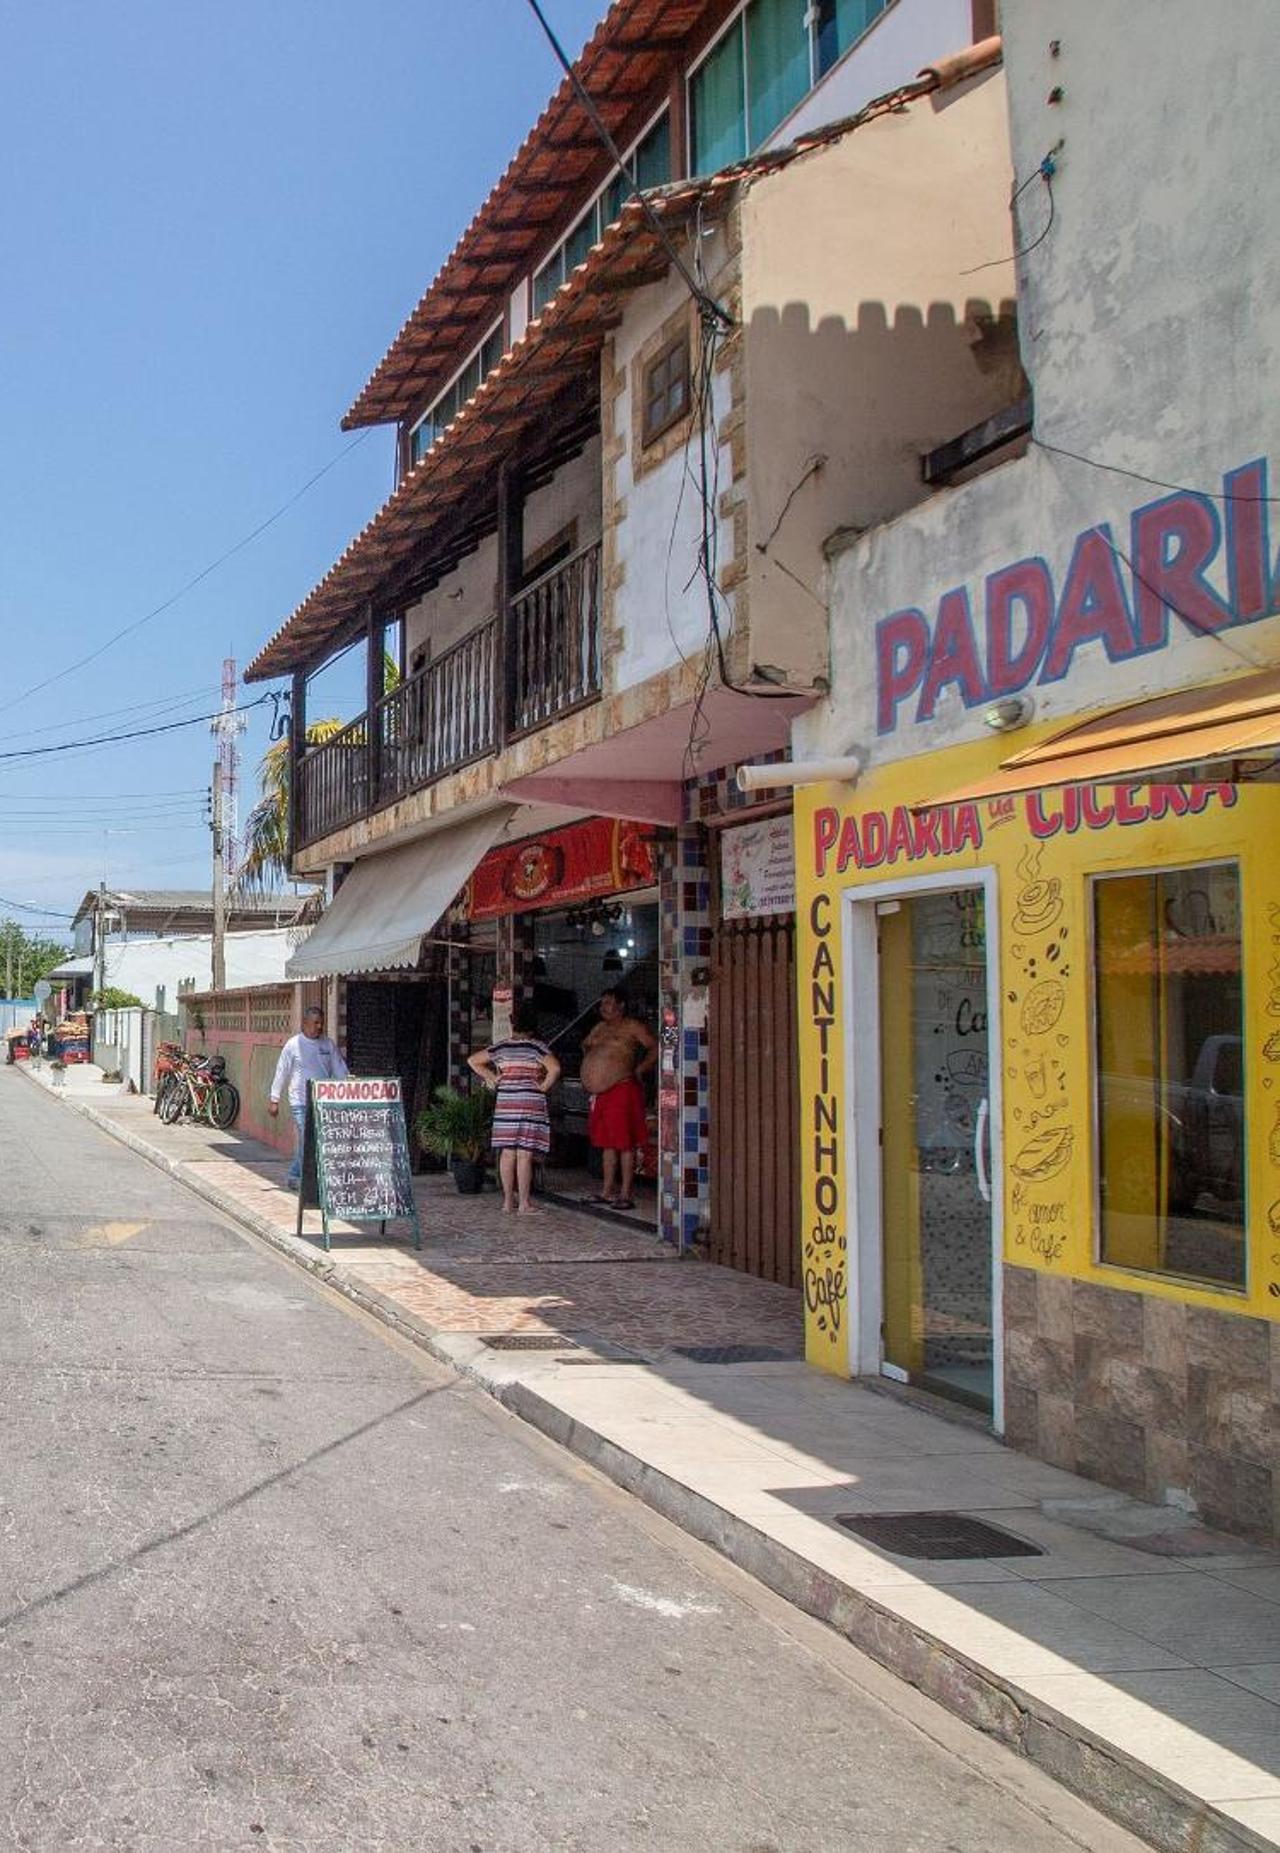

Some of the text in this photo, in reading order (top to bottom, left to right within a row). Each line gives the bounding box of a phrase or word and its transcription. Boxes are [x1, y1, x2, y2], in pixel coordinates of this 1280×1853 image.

[875, 456, 1280, 737] PADARI
[813, 804, 983, 877] PADARIA
[810, 893, 838, 1216] CANTINHO
[812, 1216, 837, 1244] do
[805, 1260, 847, 1330] Café
